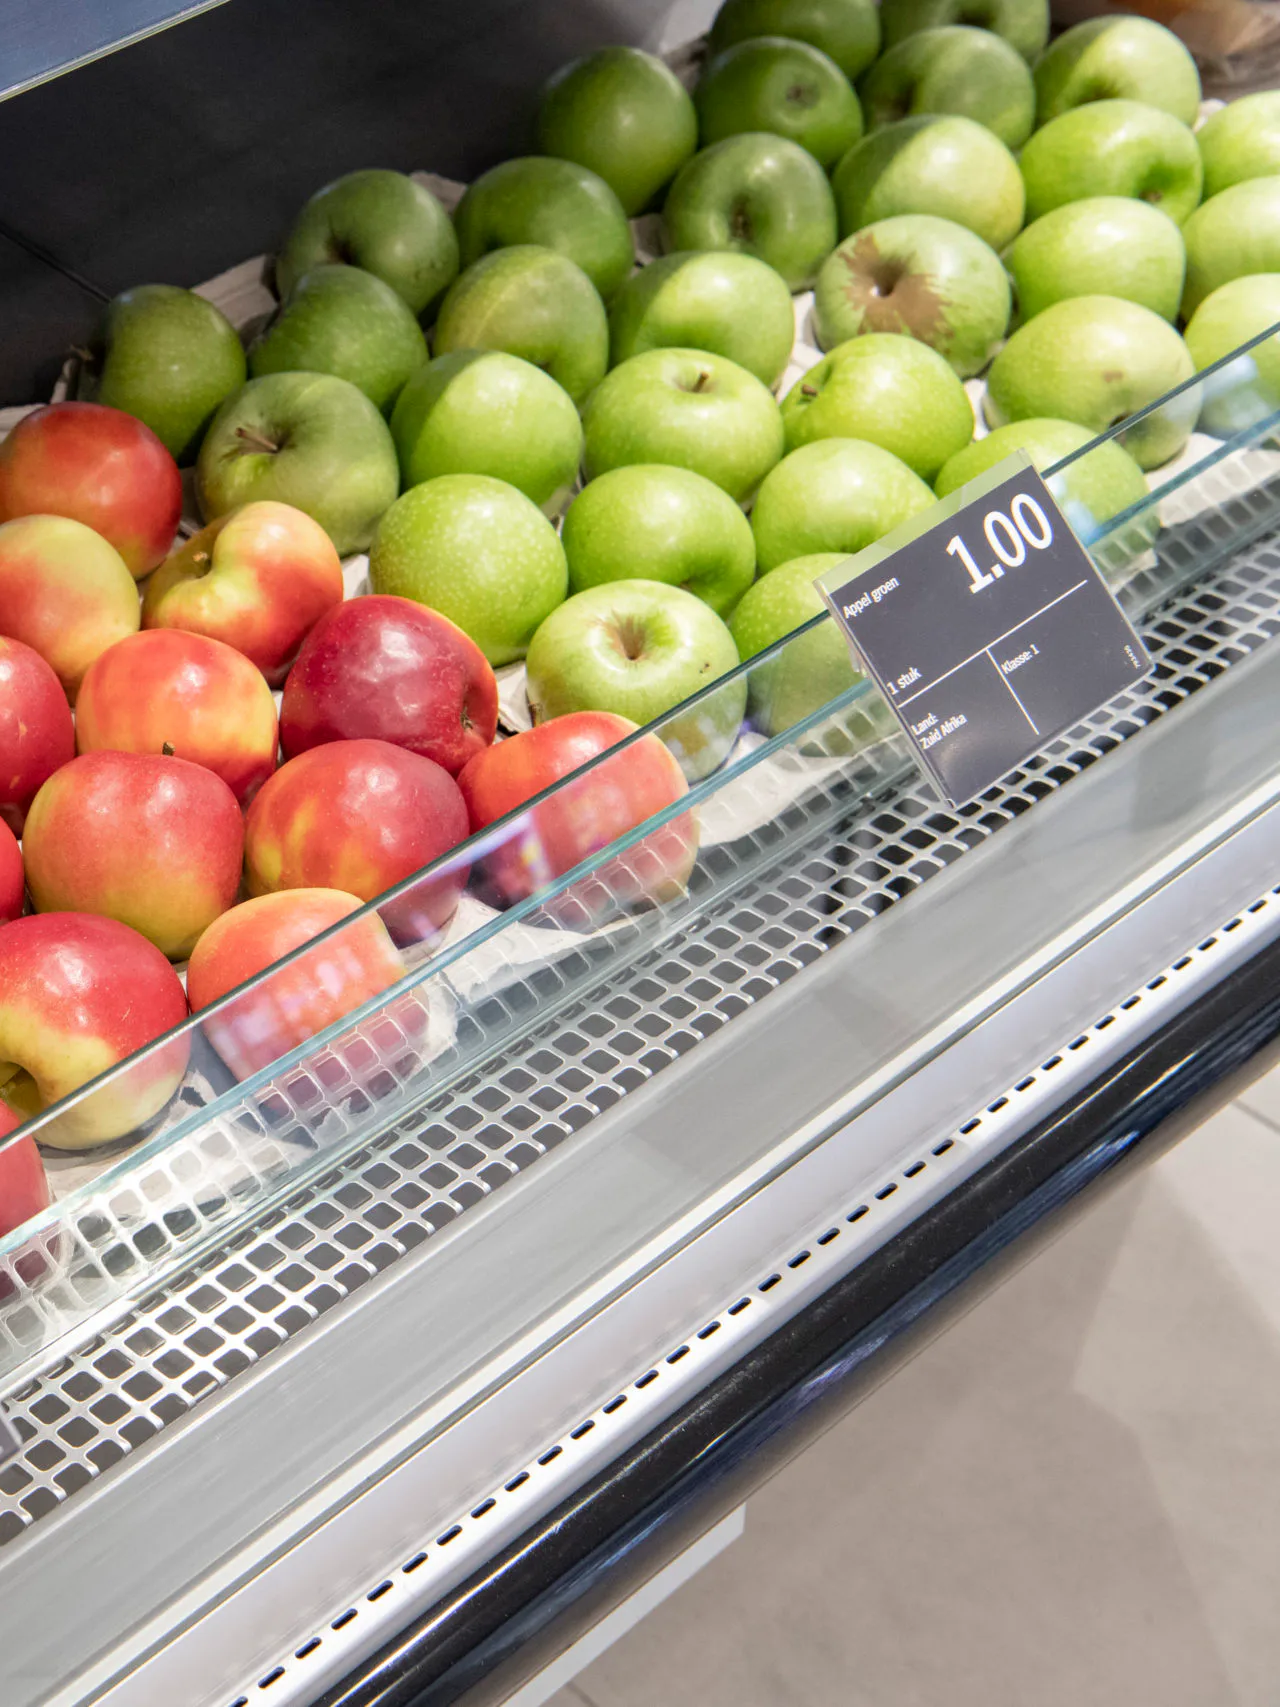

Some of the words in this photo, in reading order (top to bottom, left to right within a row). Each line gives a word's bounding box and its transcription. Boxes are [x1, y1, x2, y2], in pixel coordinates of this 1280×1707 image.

[946, 493, 1053, 594] 1.00
[842, 593, 873, 619] Appel
[871, 576, 900, 603] groen
[1000, 648, 1034, 675] Klasse:
[1029, 643, 1041, 656] 1
[887, 680, 898, 695] 1
[897, 666, 922, 690] stuk
[911, 711, 939, 736] Land:
[920, 727, 943, 751] Zuid
[939, 711, 968, 737] Afrika
